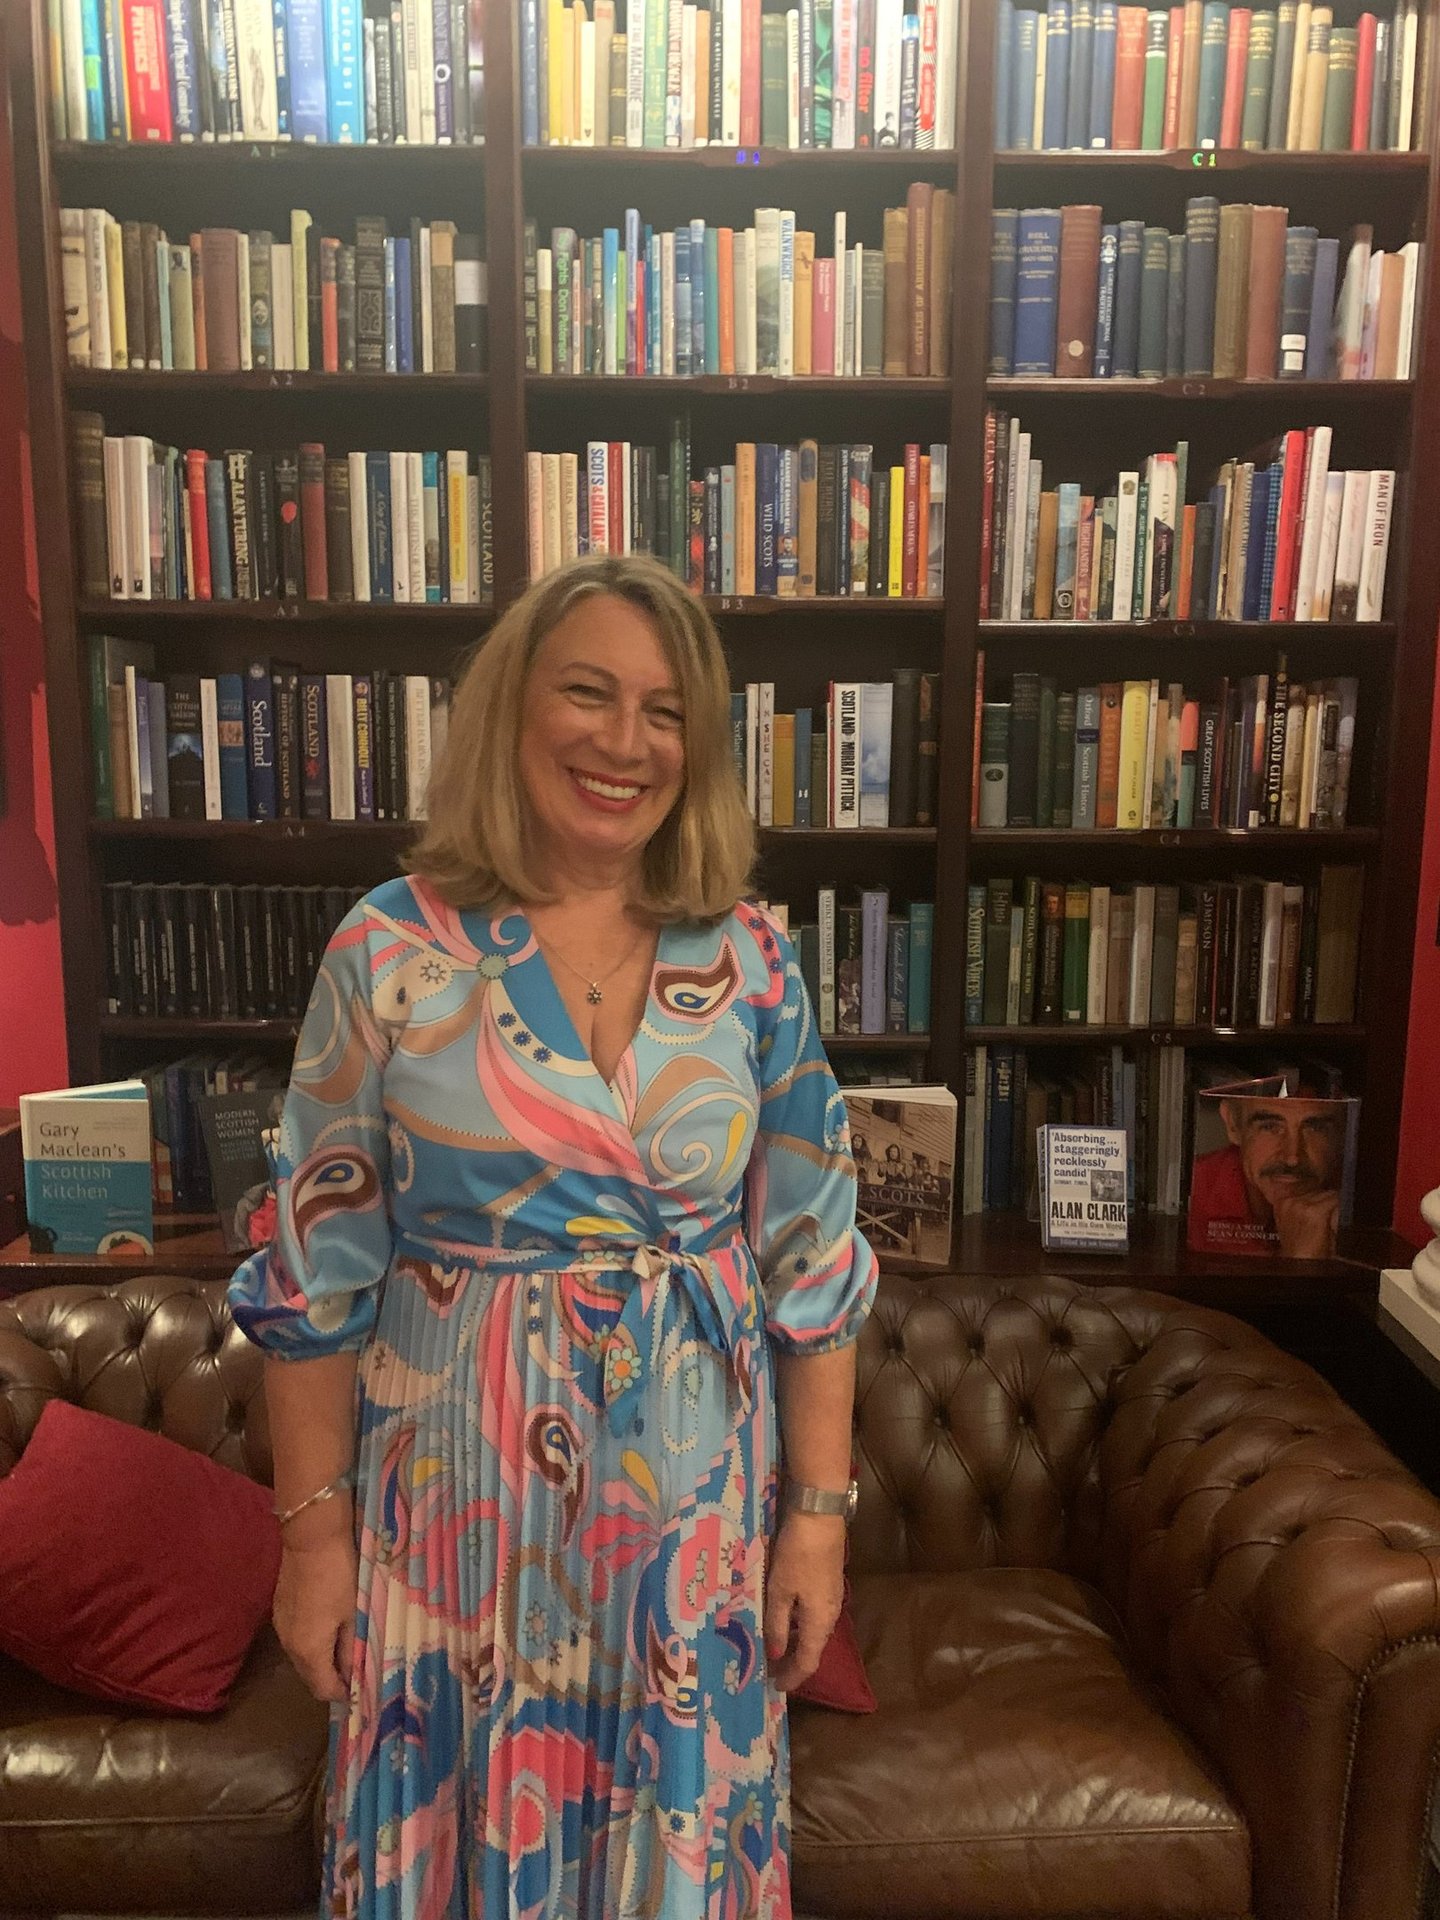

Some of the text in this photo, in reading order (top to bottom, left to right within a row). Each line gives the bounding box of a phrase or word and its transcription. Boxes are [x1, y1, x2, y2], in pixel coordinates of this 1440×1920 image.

[131, 6, 149, 73] PHYSICS
[629, 46, 644, 103] MACHINE
[858, 47, 875, 113] no filter
[556, 252, 571, 286] Fights
[780, 218, 793, 282] WAINWRIGHT
[559, 289, 570, 313] Don
[558, 314, 570, 363] Paterson
[590, 448, 605, 486] SCOTS
[985, 440, 995, 484] CLANS
[231, 480, 247, 516] ALAN
[783, 449, 793, 535] ALEXANDER GRAHAM BELL
[1373, 473, 1390, 547] MAN OF IRON
[233, 517, 249, 565] TURING
[481, 502, 495, 584] SCOTLAND
[590, 494, 606, 544] CATALANS
[763, 503, 773, 567] WILD SCOTS
[1079, 522, 1091, 578] HIGHLANDERS
[252, 700, 272, 768] Scotland
[282, 735, 288, 747] OF
[307, 684, 320, 758] SCOTLAND
[357, 698, 369, 768] BILLY CONNOLLY
[1268, 684, 1287, 792] THE SECOND CITY
[282, 751, 290, 799] SCOTLAND
[841, 690, 856, 812] SCOTLAND MURRAY PITTOCK
[1079, 694, 1094, 817] Oxford Scottish History
[1201, 719, 1214, 810] GREAT SCOTTISH LIVES
[1026, 906, 1036, 949] SCOTLAND
[1202, 895, 1214, 950] SIMPSON
[965, 907, 985, 998] SCOTTISH VOICES
[39, 1122, 79, 1140] Gary
[216, 1118, 260, 1130] SCOTTISH
[217, 1127, 256, 1139] WOMEN
[40, 1143, 126, 1158] Maclean's
[41, 1163, 112, 1180] Scottish
[1054, 1156, 1107, 1169] recklessly
[42, 1184, 109, 1200] Kitchen
[869, 1185, 925, 1206] SCOTS
[1051, 1201, 1126, 1222] ALAN CLARK
[1234, 1231, 1280, 1241] CONNERY
